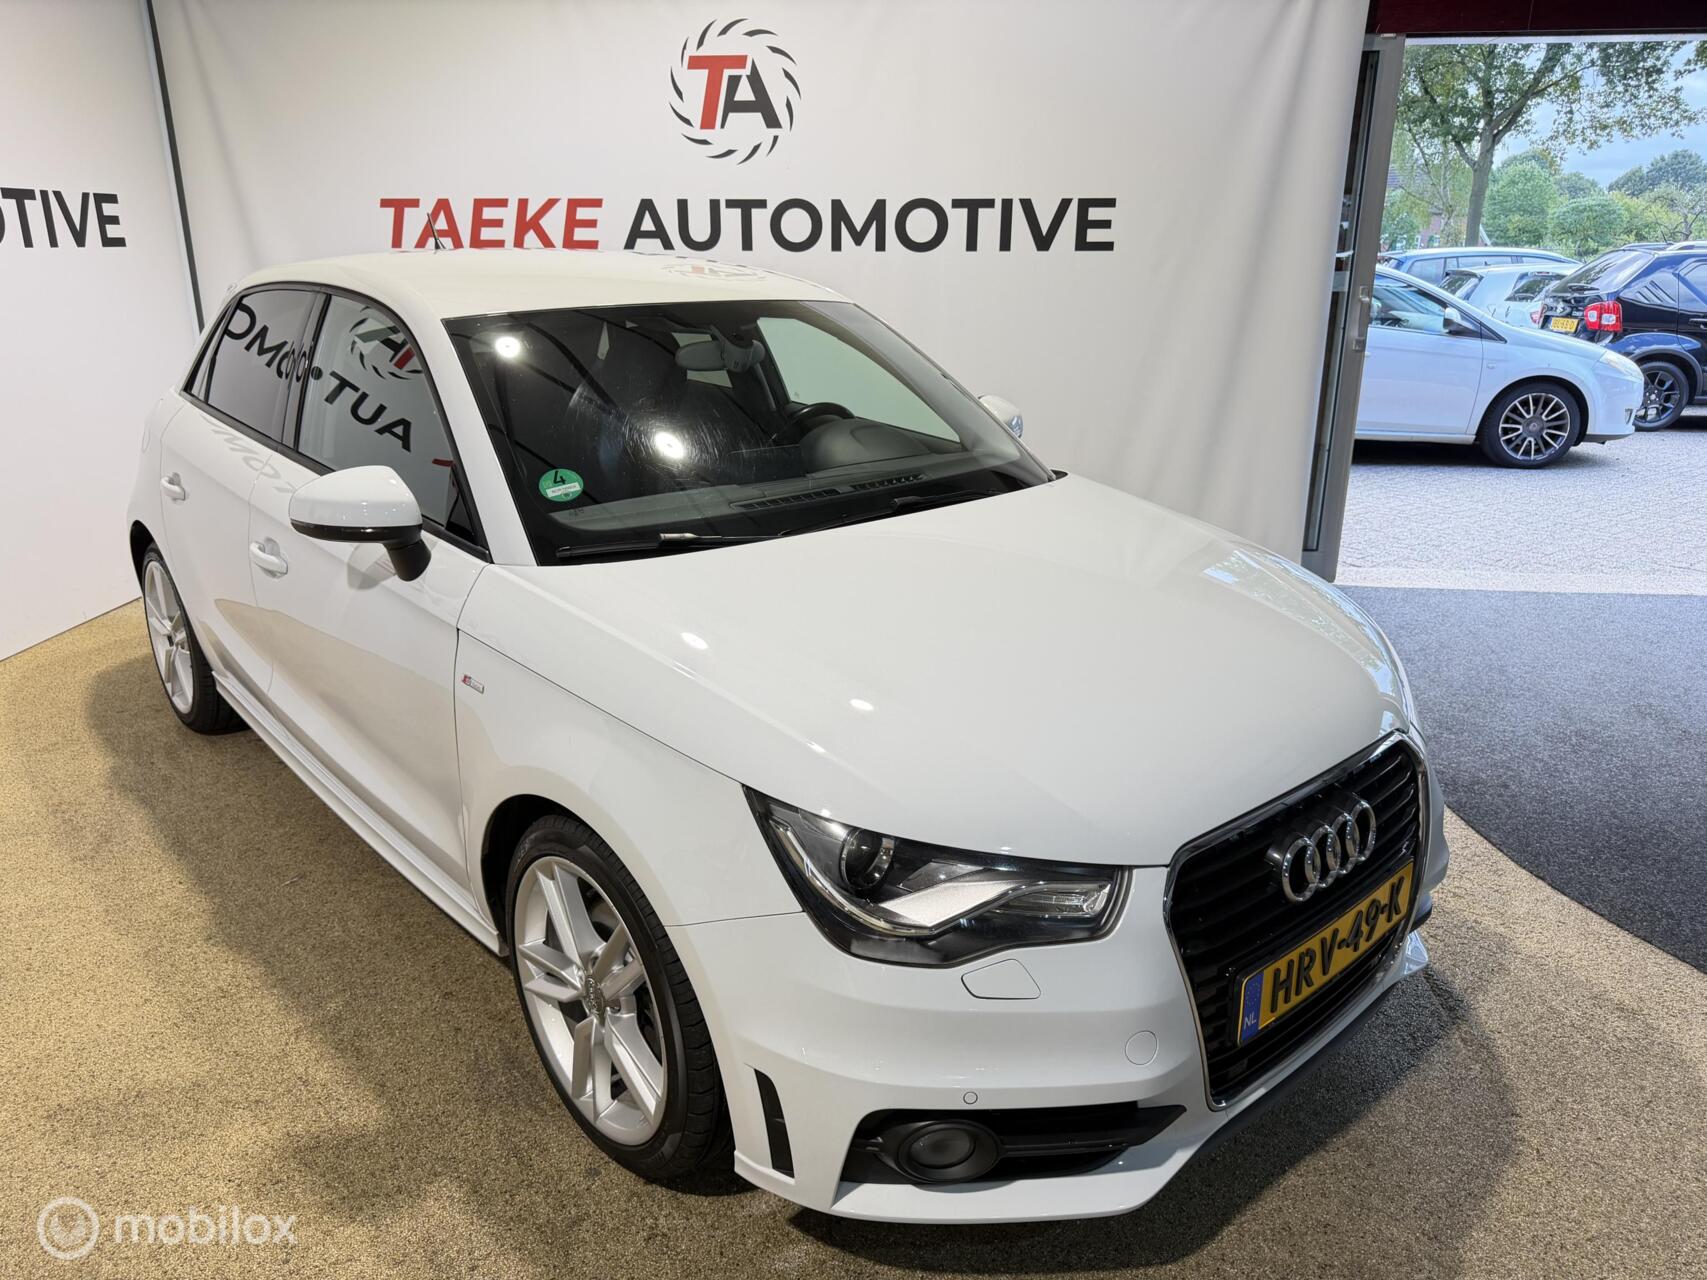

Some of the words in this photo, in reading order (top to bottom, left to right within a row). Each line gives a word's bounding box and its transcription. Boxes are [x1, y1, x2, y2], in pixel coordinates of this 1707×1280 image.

[687, 54, 784, 130] TA
[0, 187, 127, 248] TIVE
[379, 197, 604, 250] TAEKE
[623, 197, 1117, 253] AUTOMOTIVE
[553, 470, 566, 484] 4
[1270, 875, 1405, 1014] HRV-49-K
[1243, 1011, 1257, 1031] NL
